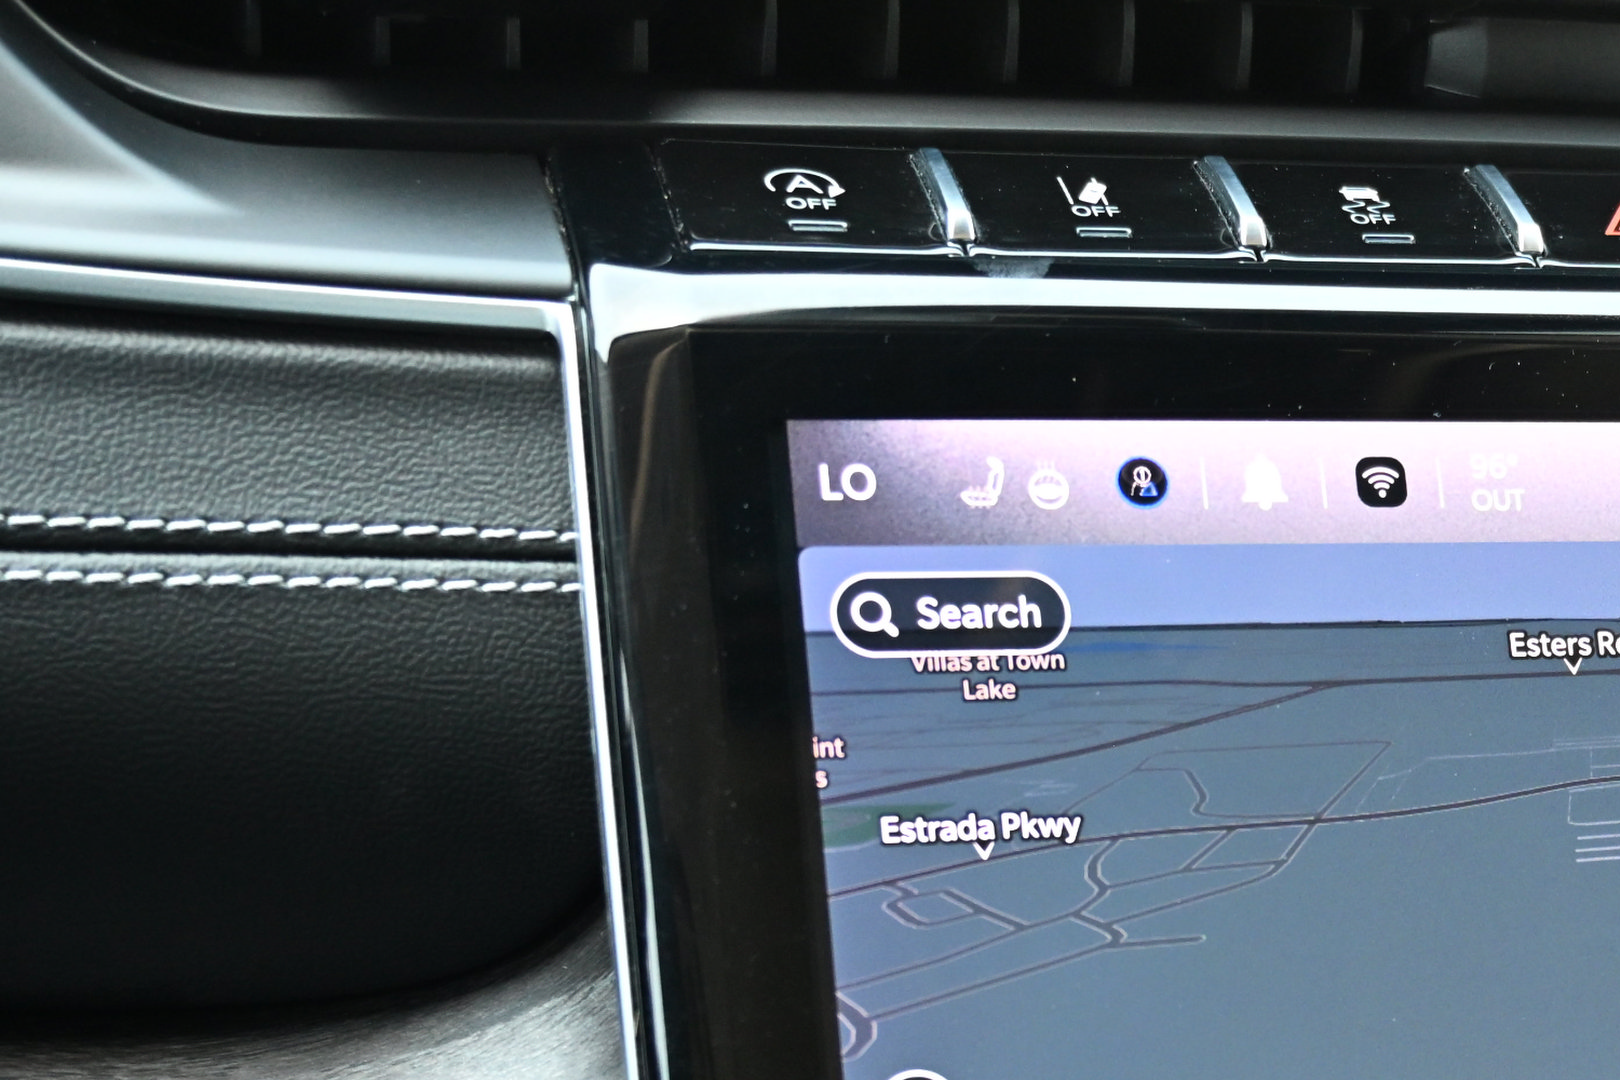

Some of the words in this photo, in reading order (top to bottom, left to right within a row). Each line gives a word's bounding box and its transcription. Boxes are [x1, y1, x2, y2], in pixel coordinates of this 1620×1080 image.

[785, 197, 837, 210] OFF
[1071, 205, 1121, 217] OFF
[1350, 213, 1397, 225] OFF
[818, 462, 878, 501] LO
[1471, 488, 1526, 512] OUT
[916, 594, 1042, 629] Search
[1509, 633, 1593, 658] Esters
[977, 655, 1000, 671] at
[1007, 654, 1065, 671] Town
[962, 678, 1016, 700] Lake
[880, 812, 996, 844] Estrada
[1000, 811, 1082, 844] Pkwy
